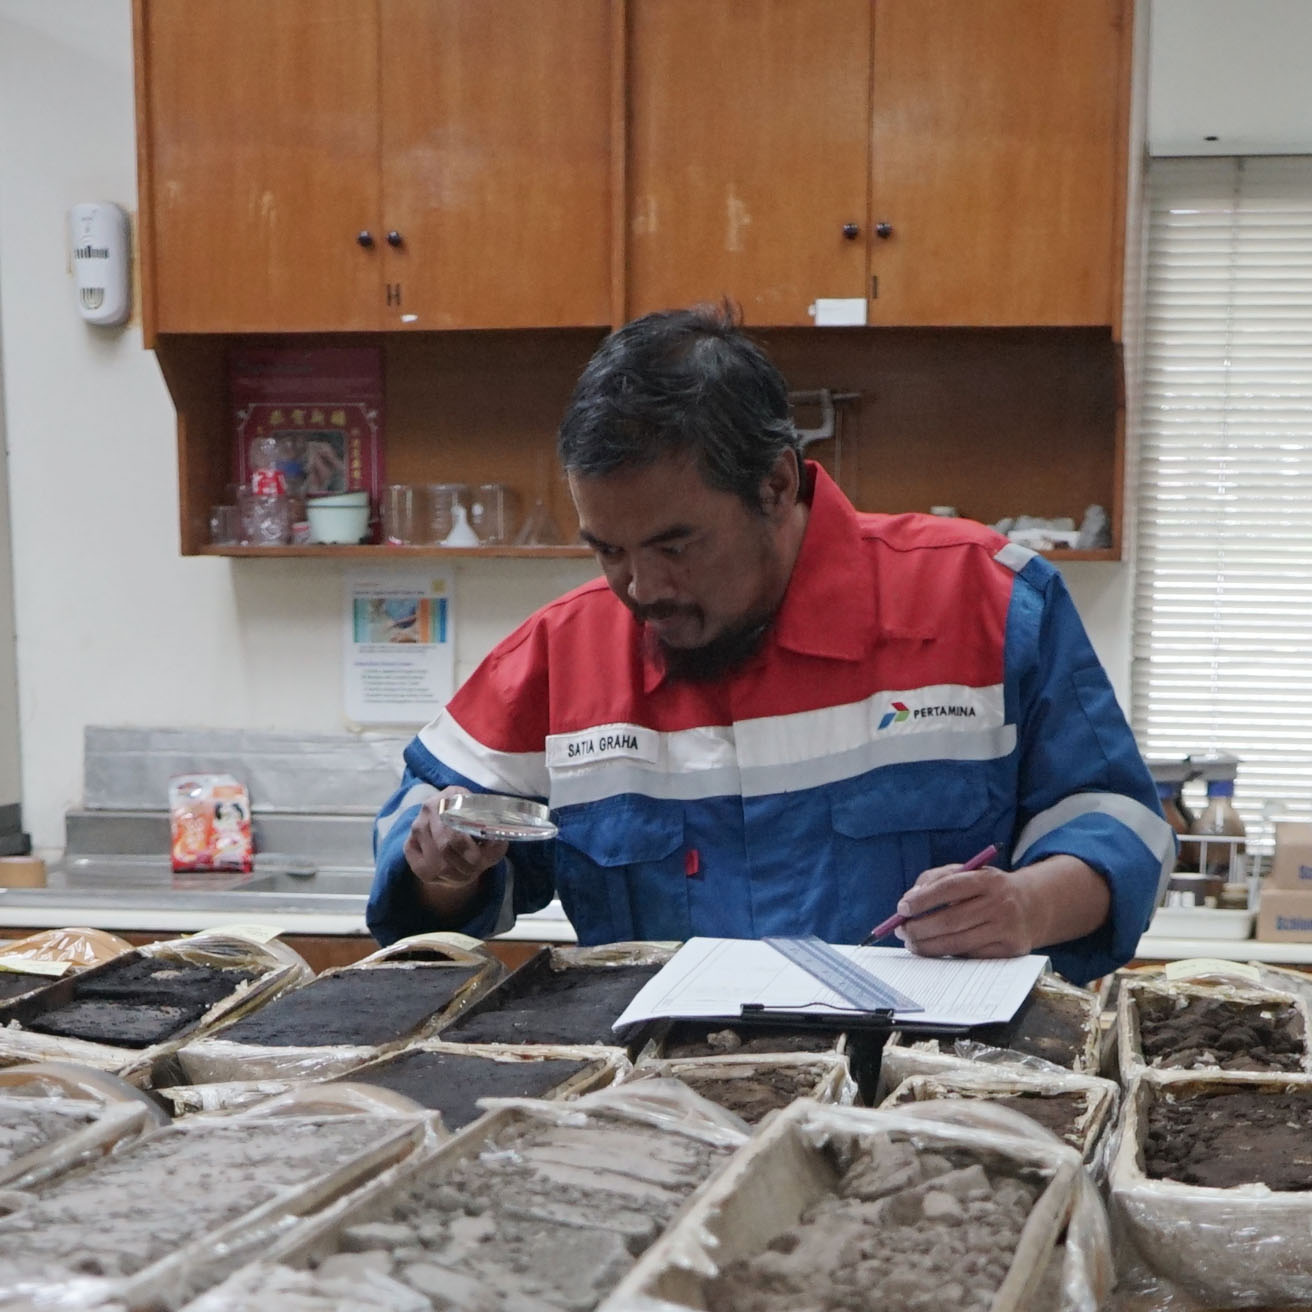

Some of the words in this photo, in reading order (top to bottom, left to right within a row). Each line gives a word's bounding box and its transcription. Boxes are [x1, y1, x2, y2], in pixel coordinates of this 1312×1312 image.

[386, 283, 401, 306] H
[913, 705, 976, 719] PERTAMINA
[568, 739, 595, 757] SATIA
[599, 734, 638, 751] GRAHA
